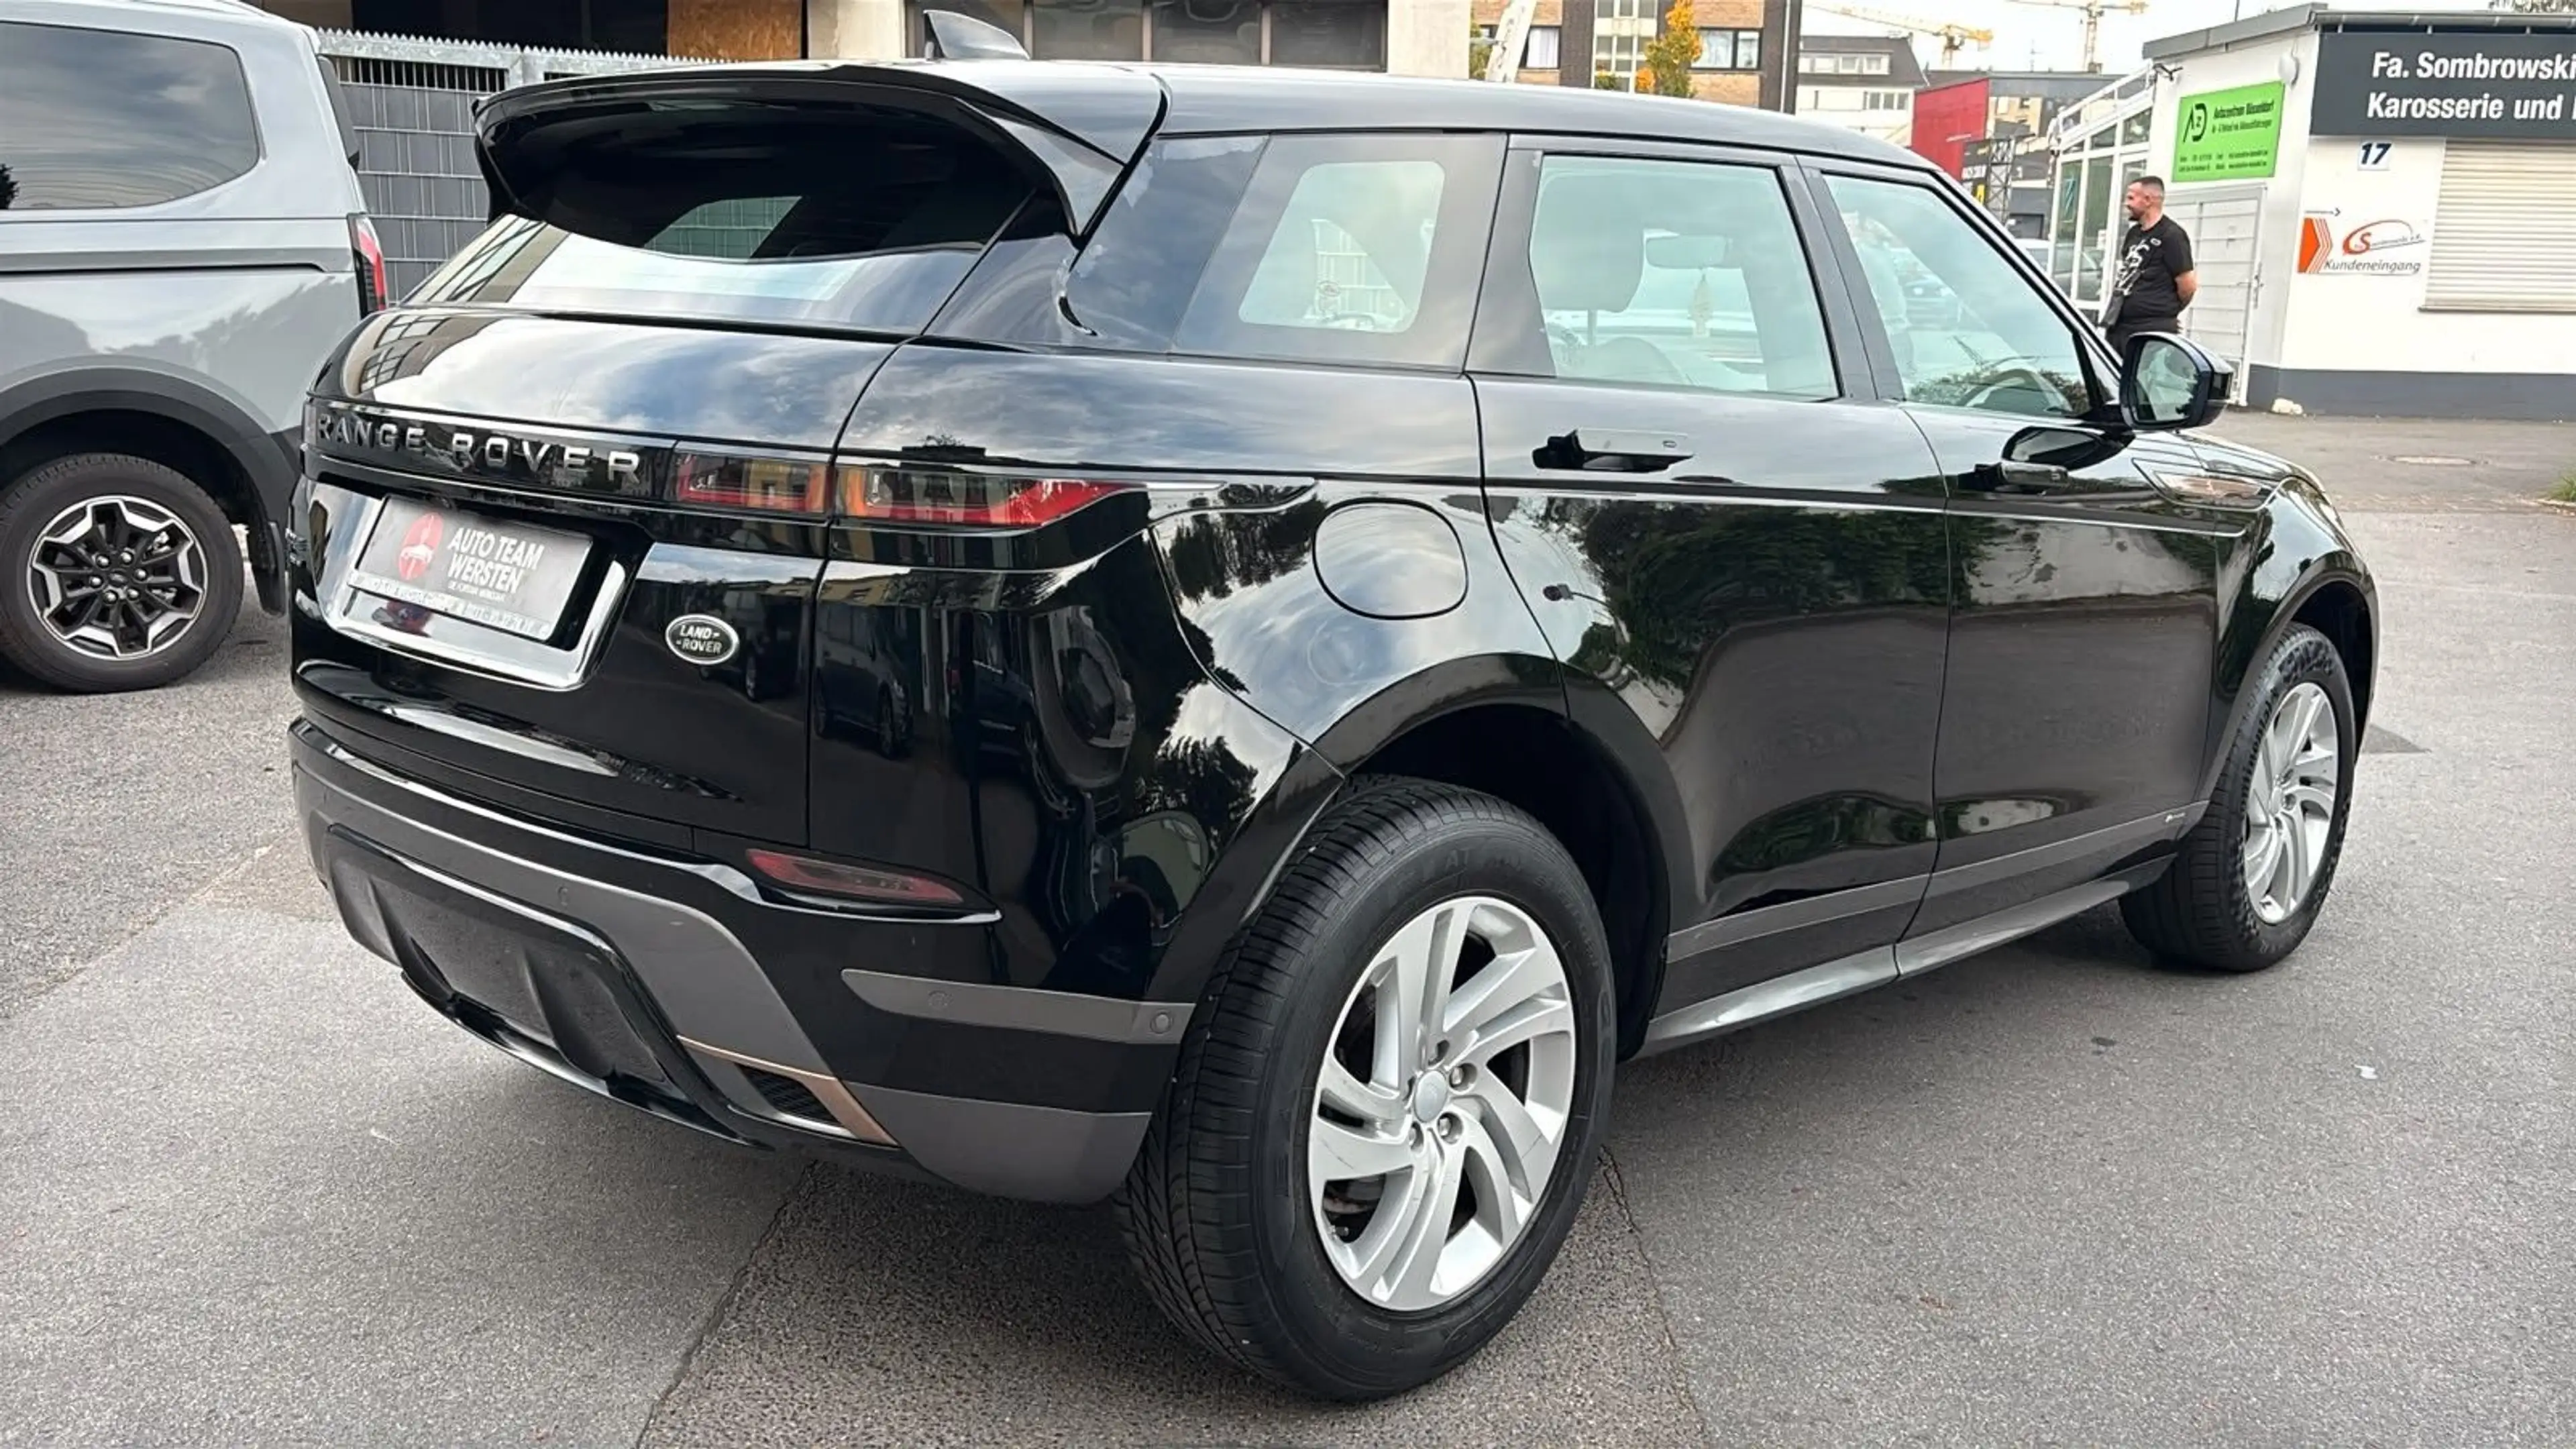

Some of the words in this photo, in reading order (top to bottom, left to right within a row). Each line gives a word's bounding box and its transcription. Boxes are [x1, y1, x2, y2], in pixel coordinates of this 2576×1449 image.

[2372, 52, 2409, 78] Fa.
[2416, 52, 2576, 80] Sombrowski
[2367, 92, 2504, 119] Karosserie
[2514, 94, 2564, 120] und
[2360, 143, 2391, 165] 17
[2324, 259, 2421, 274] Kundeneingang
[316, 413, 427, 451] RANGE
[451, 432, 641, 486] ROVER
[447, 527, 496, 558] AUTO
[494, 536, 545, 571] TEAM
[447, 552, 525, 594] WERSTEN
